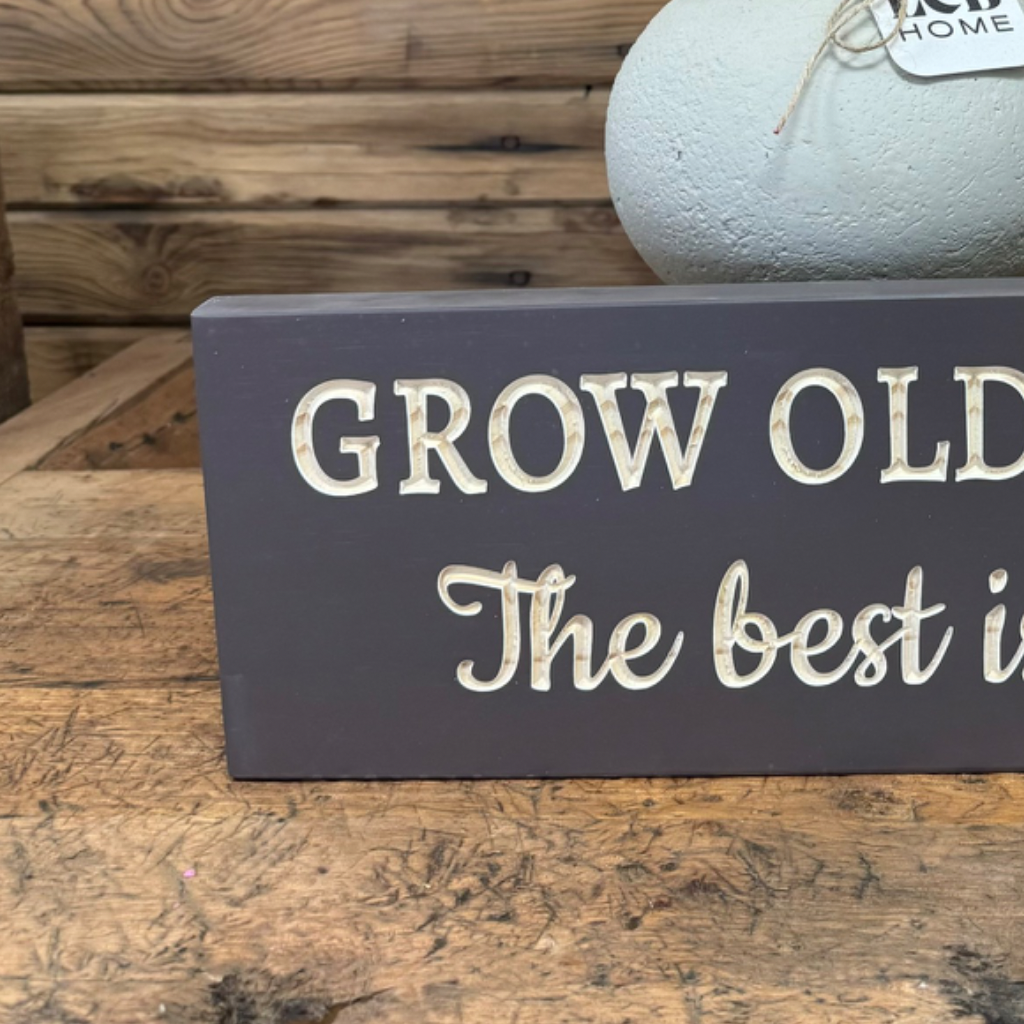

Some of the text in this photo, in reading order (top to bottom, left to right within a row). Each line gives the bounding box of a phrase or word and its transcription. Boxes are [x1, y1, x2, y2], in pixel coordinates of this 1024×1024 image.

[898, 14, 1014, 42] HOME
[289, 370, 728, 497] GROW
[436, 560, 685, 693] The
[712, 559, 954, 689] best
